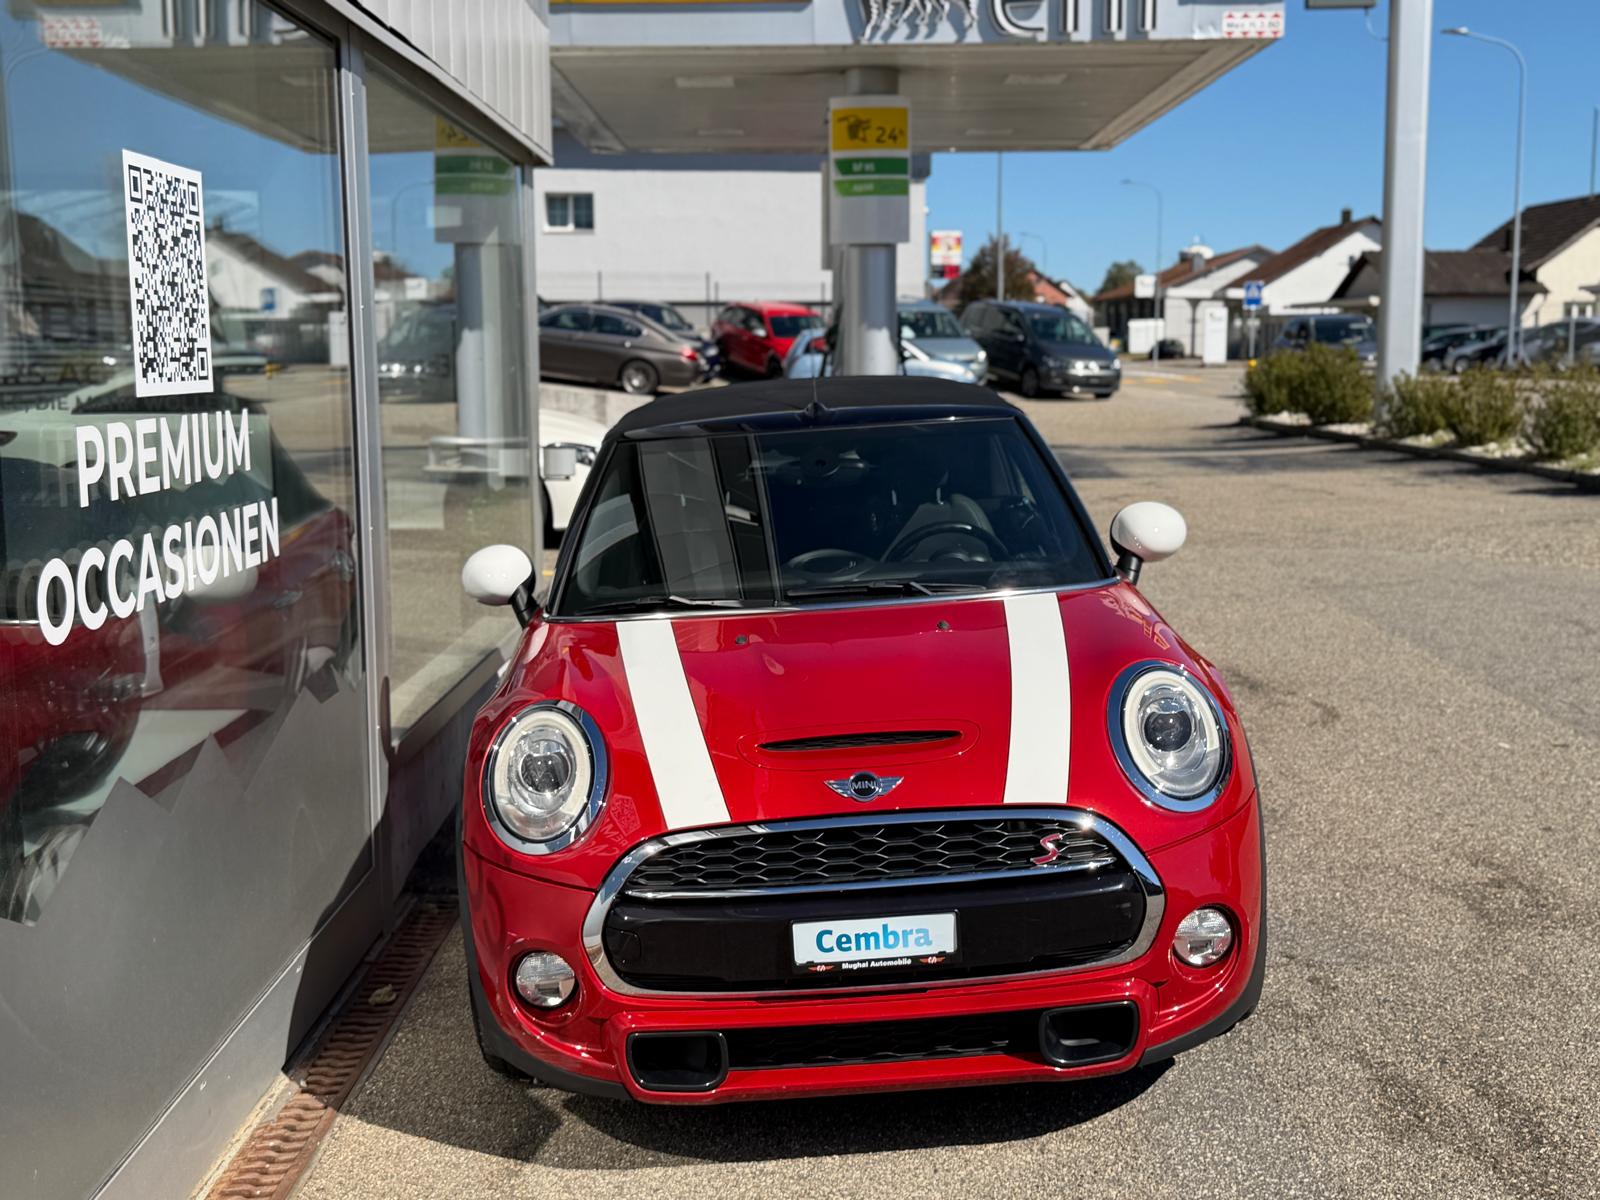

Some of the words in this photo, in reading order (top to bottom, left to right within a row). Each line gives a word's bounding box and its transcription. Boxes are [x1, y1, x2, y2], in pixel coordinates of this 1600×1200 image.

[76, 408, 251, 508] PREMIUM
[37, 497, 280, 646] OCCASIONEN
[851, 780, 878, 790] MINI
[1030, 833, 1063, 865] S
[816, 923, 933, 953] Cembra
[841, 961, 869, 970] Mughal
[870, 957, 912, 967] Automobile
